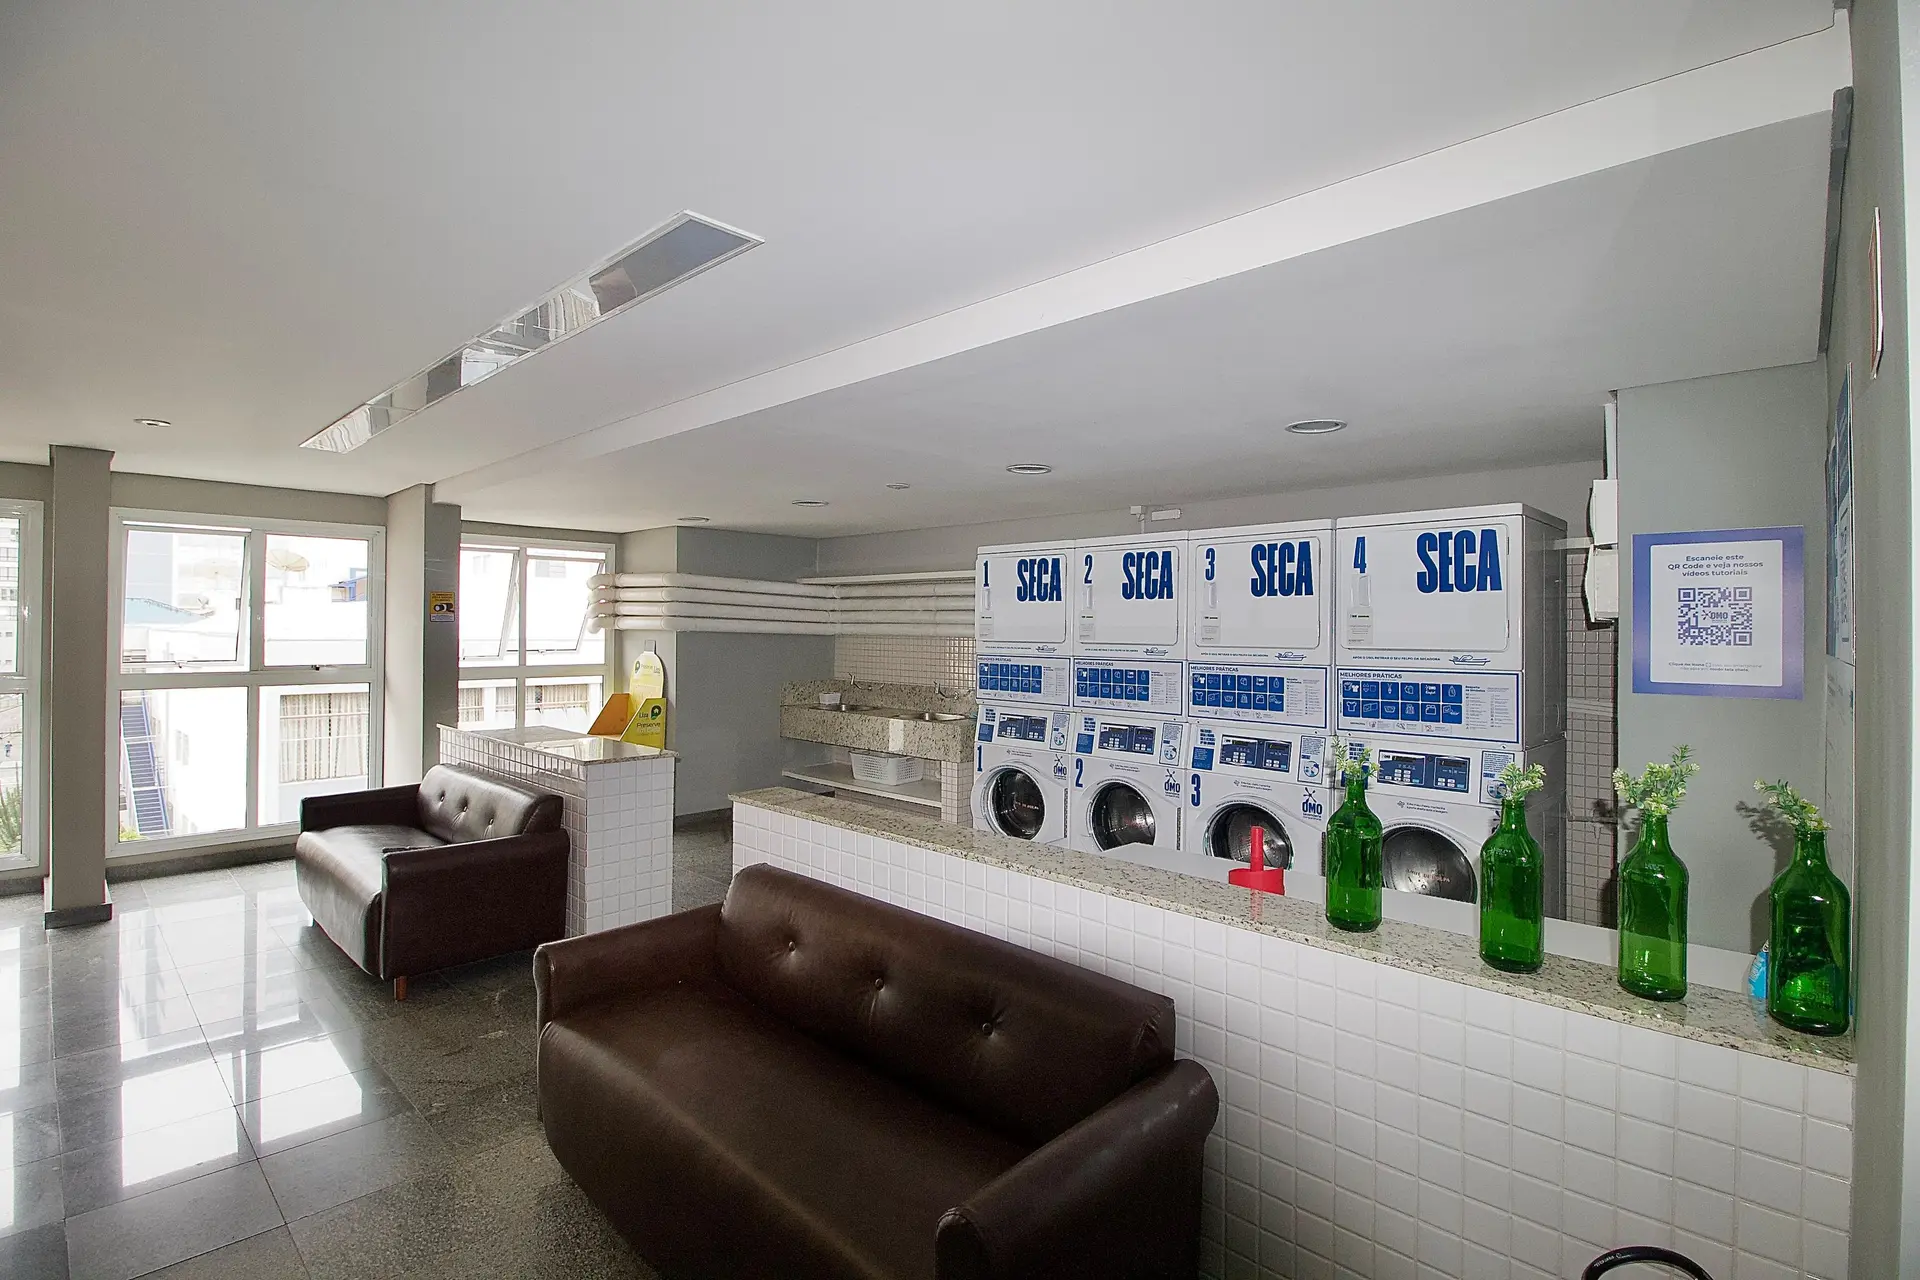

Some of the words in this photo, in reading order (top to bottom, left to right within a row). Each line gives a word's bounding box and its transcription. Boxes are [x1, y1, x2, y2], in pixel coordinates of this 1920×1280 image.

[1084, 554, 1093, 584] 2
[1205, 547, 1216, 581] 3
[1250, 539, 1314, 598] SECA
[1353, 536, 1367, 574] 4
[1416, 527, 1503, 594] SECA
[1713, 562, 1731, 570] veja
[983, 560, 990, 587] 1
[1016, 556, 1062, 602] SECA
[1121, 549, 1174, 600] SECA
[1710, 611, 1728, 620] OMO
[976, 744, 983, 772] 1
[1053, 766, 1067, 776] OMO
[1075, 757, 1084, 788] 2
[1164, 781, 1181, 793] OMO
[1190, 773, 1201, 807] 3
[1302, 801, 1323, 815] OMO
